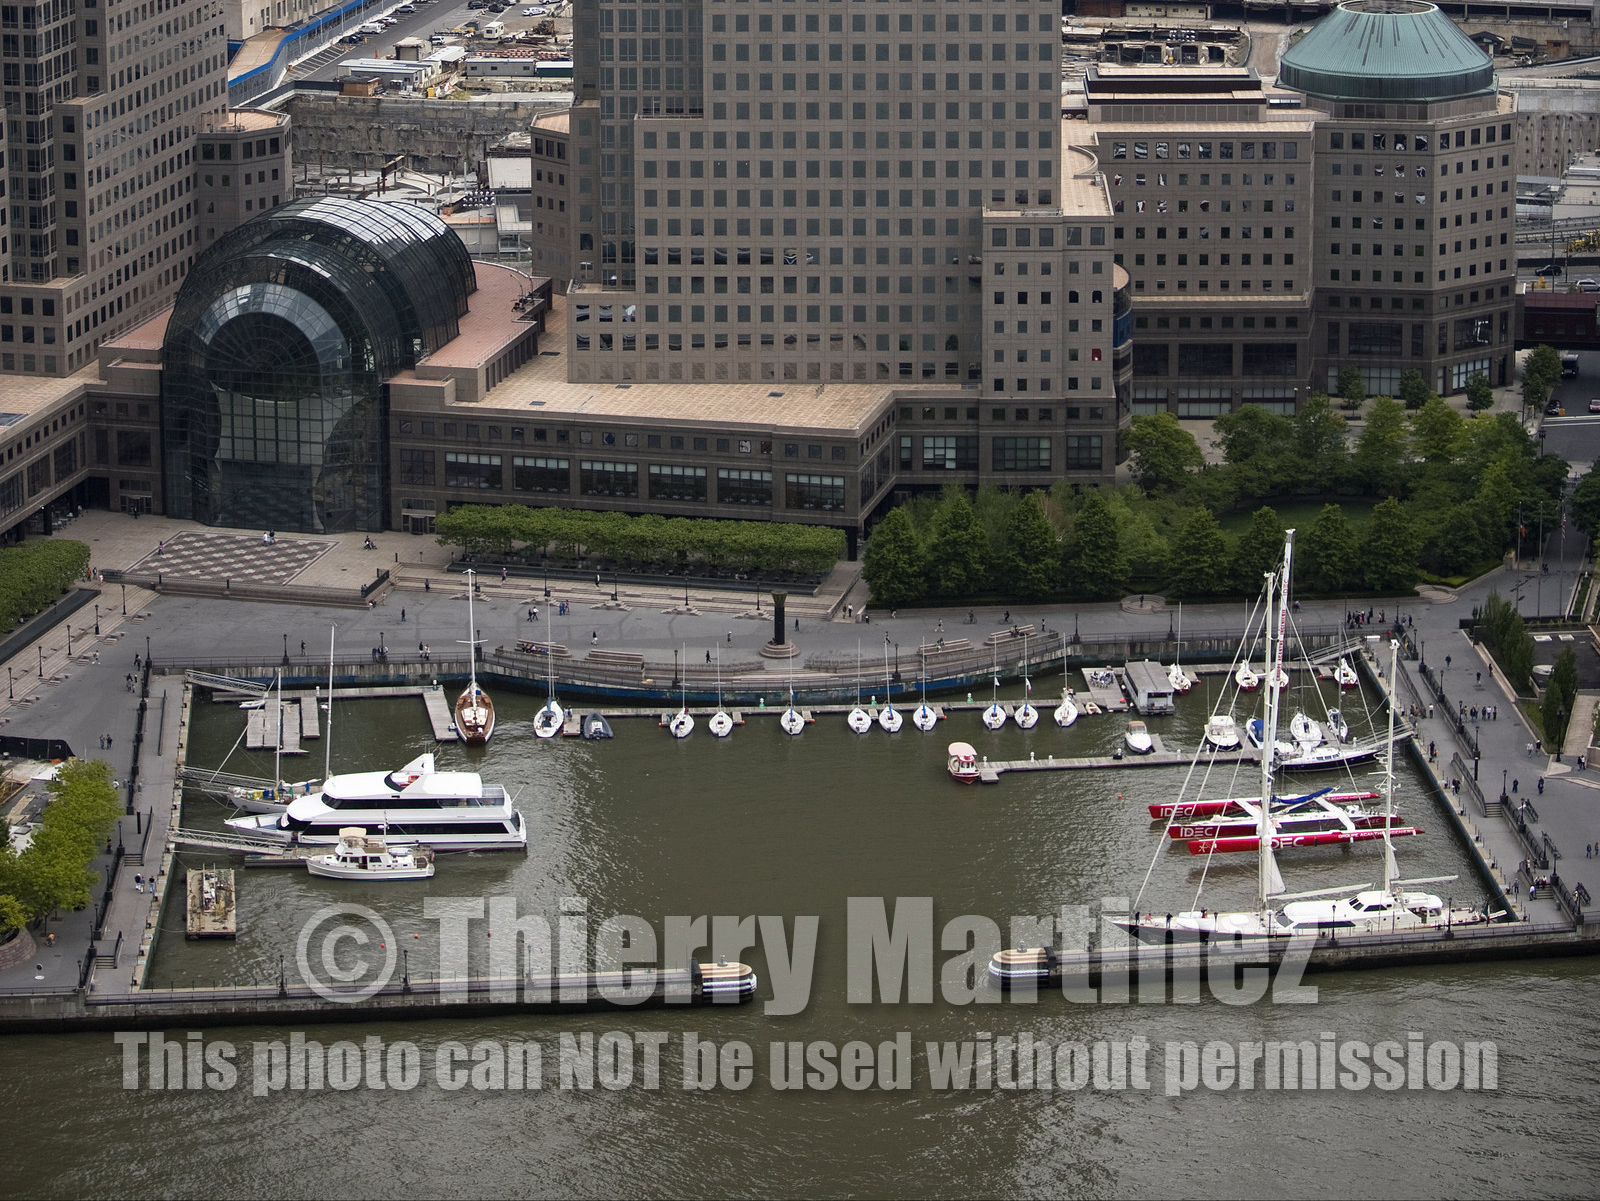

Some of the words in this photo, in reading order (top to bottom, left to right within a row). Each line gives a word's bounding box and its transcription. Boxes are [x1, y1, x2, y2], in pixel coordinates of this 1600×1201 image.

[1160, 807, 1192, 817] IDEC
[1180, 827, 1213, 837] IDEC
[1271, 837, 1304, 849] DEC
